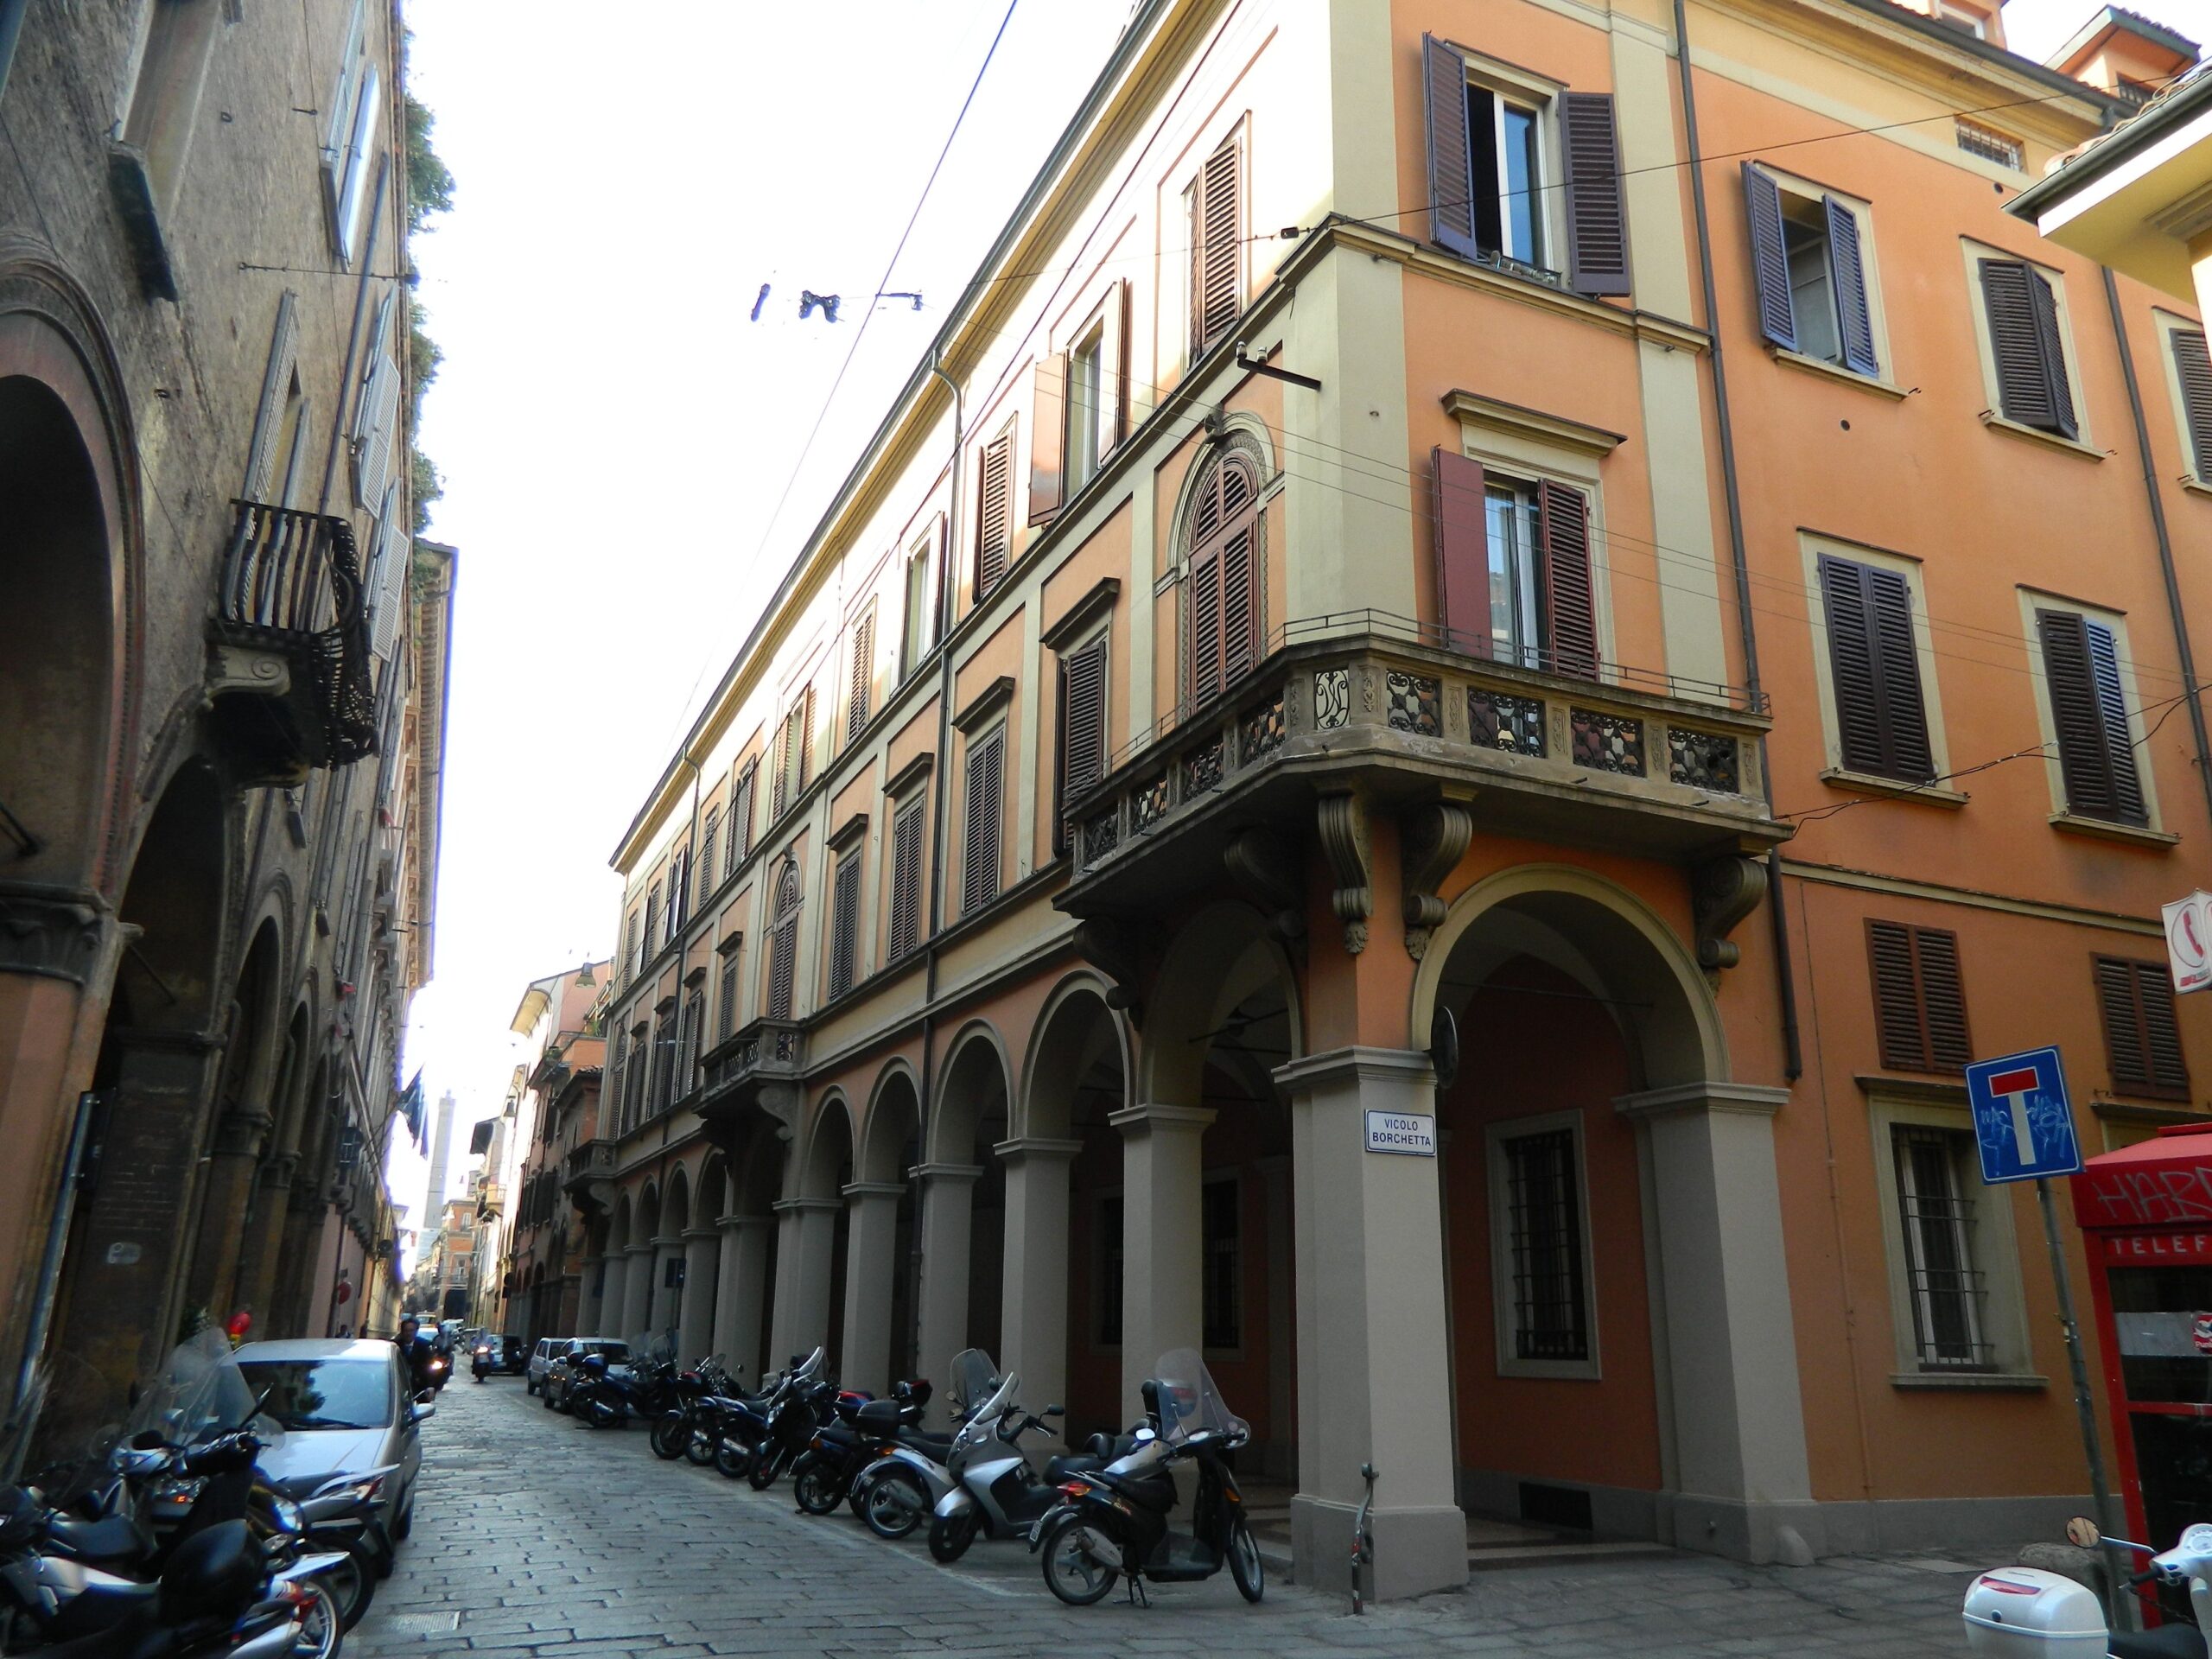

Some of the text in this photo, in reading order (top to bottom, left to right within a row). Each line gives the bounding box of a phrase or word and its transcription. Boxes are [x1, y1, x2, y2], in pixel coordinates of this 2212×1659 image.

[1384, 1118, 1419, 1131] VICOLO
[1372, 1132, 1431, 1146] BORCHETTA
[2112, 1235, 2206, 1255] TELEF
